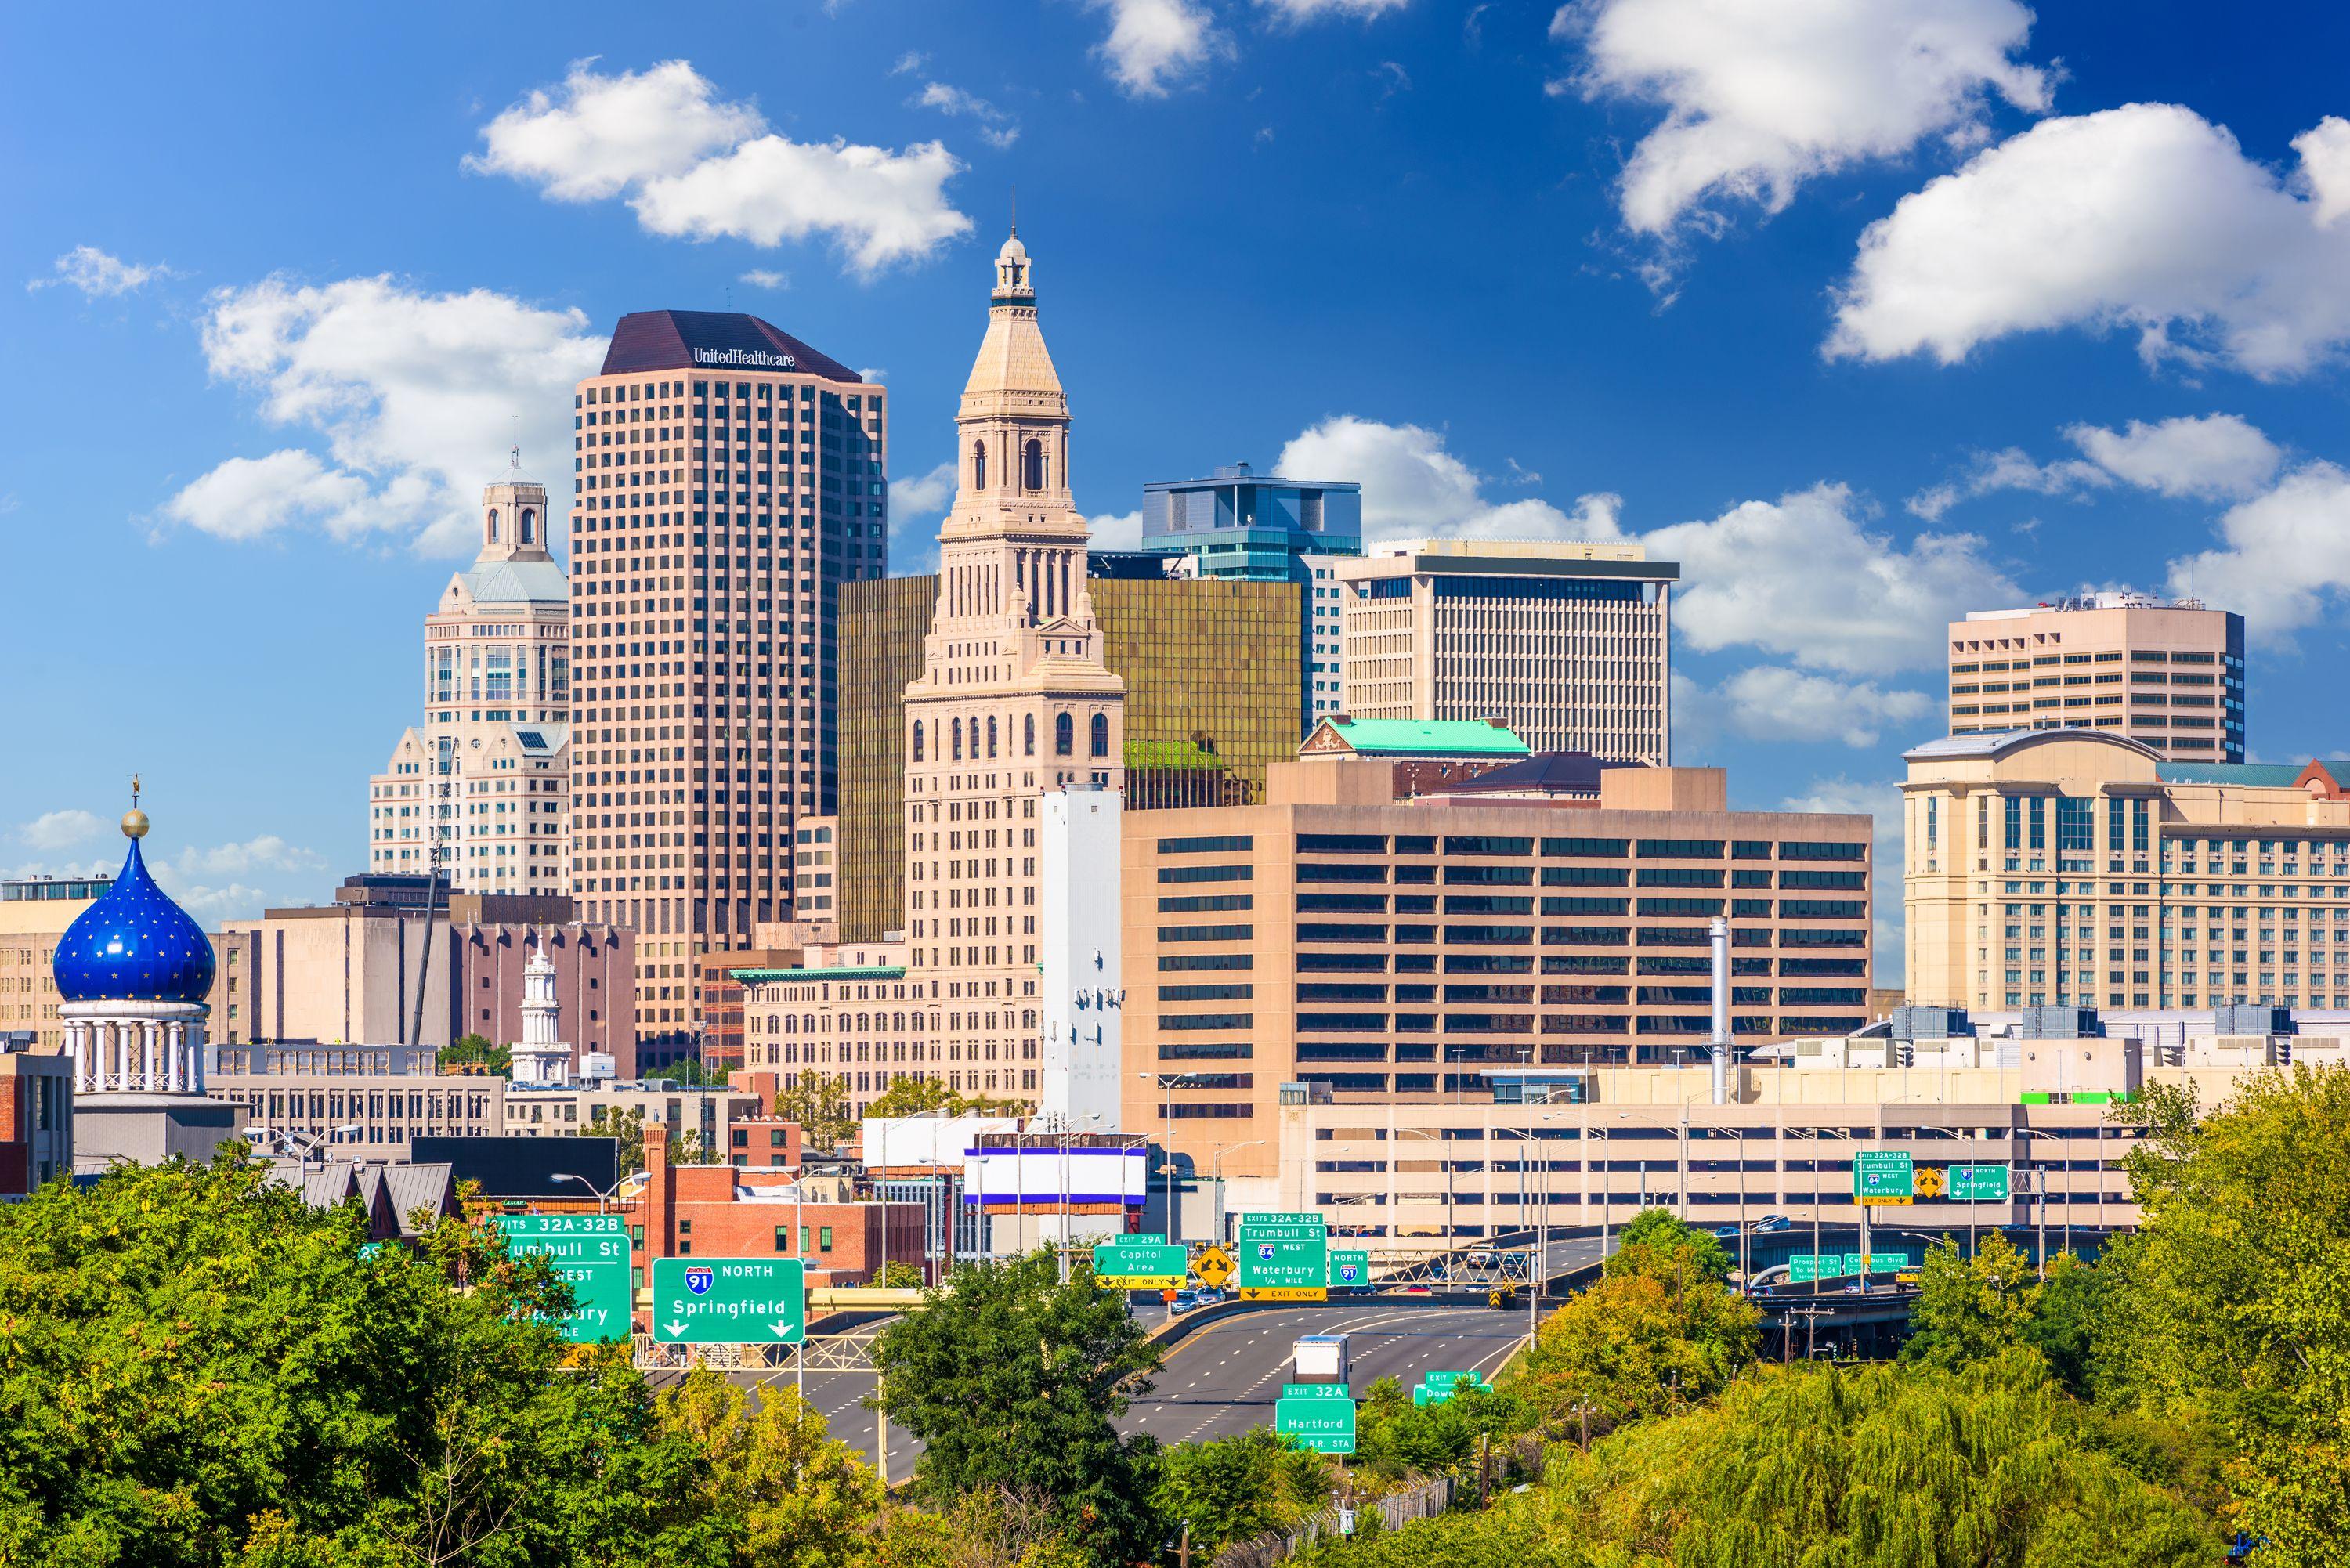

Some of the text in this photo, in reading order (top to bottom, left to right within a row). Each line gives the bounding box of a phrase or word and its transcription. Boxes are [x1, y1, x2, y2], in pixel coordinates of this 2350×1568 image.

[694, 347, 795, 367] UnitedHealthcare
[1956, 1181, 2001, 1190] Springfield
[1862, 1187, 1904, 1195] Waterbury
[539, 1218, 619, 1232] 32A-32B
[1246, 1228, 1321, 1237] Trumbull St
[508, 1241, 620, 1256] umbull St
[1260, 1248, 1273, 1256] 84
[1120, 1250, 1161, 1260] Capitol
[722, 1266, 773, 1277] NORTH
[1127, 1263, 1155, 1272] Area
[1253, 1265, 1314, 1277] Waterbury
[1343, 1270, 1354, 1278] 91
[689, 1275, 707, 1289] 91
[672, 1299, 786, 1320] Springfield
[553, 1327, 579, 1337] ILE
[1315, 1386, 1343, 1396] 32A
[1289, 1418, 1343, 1429] Hartford
